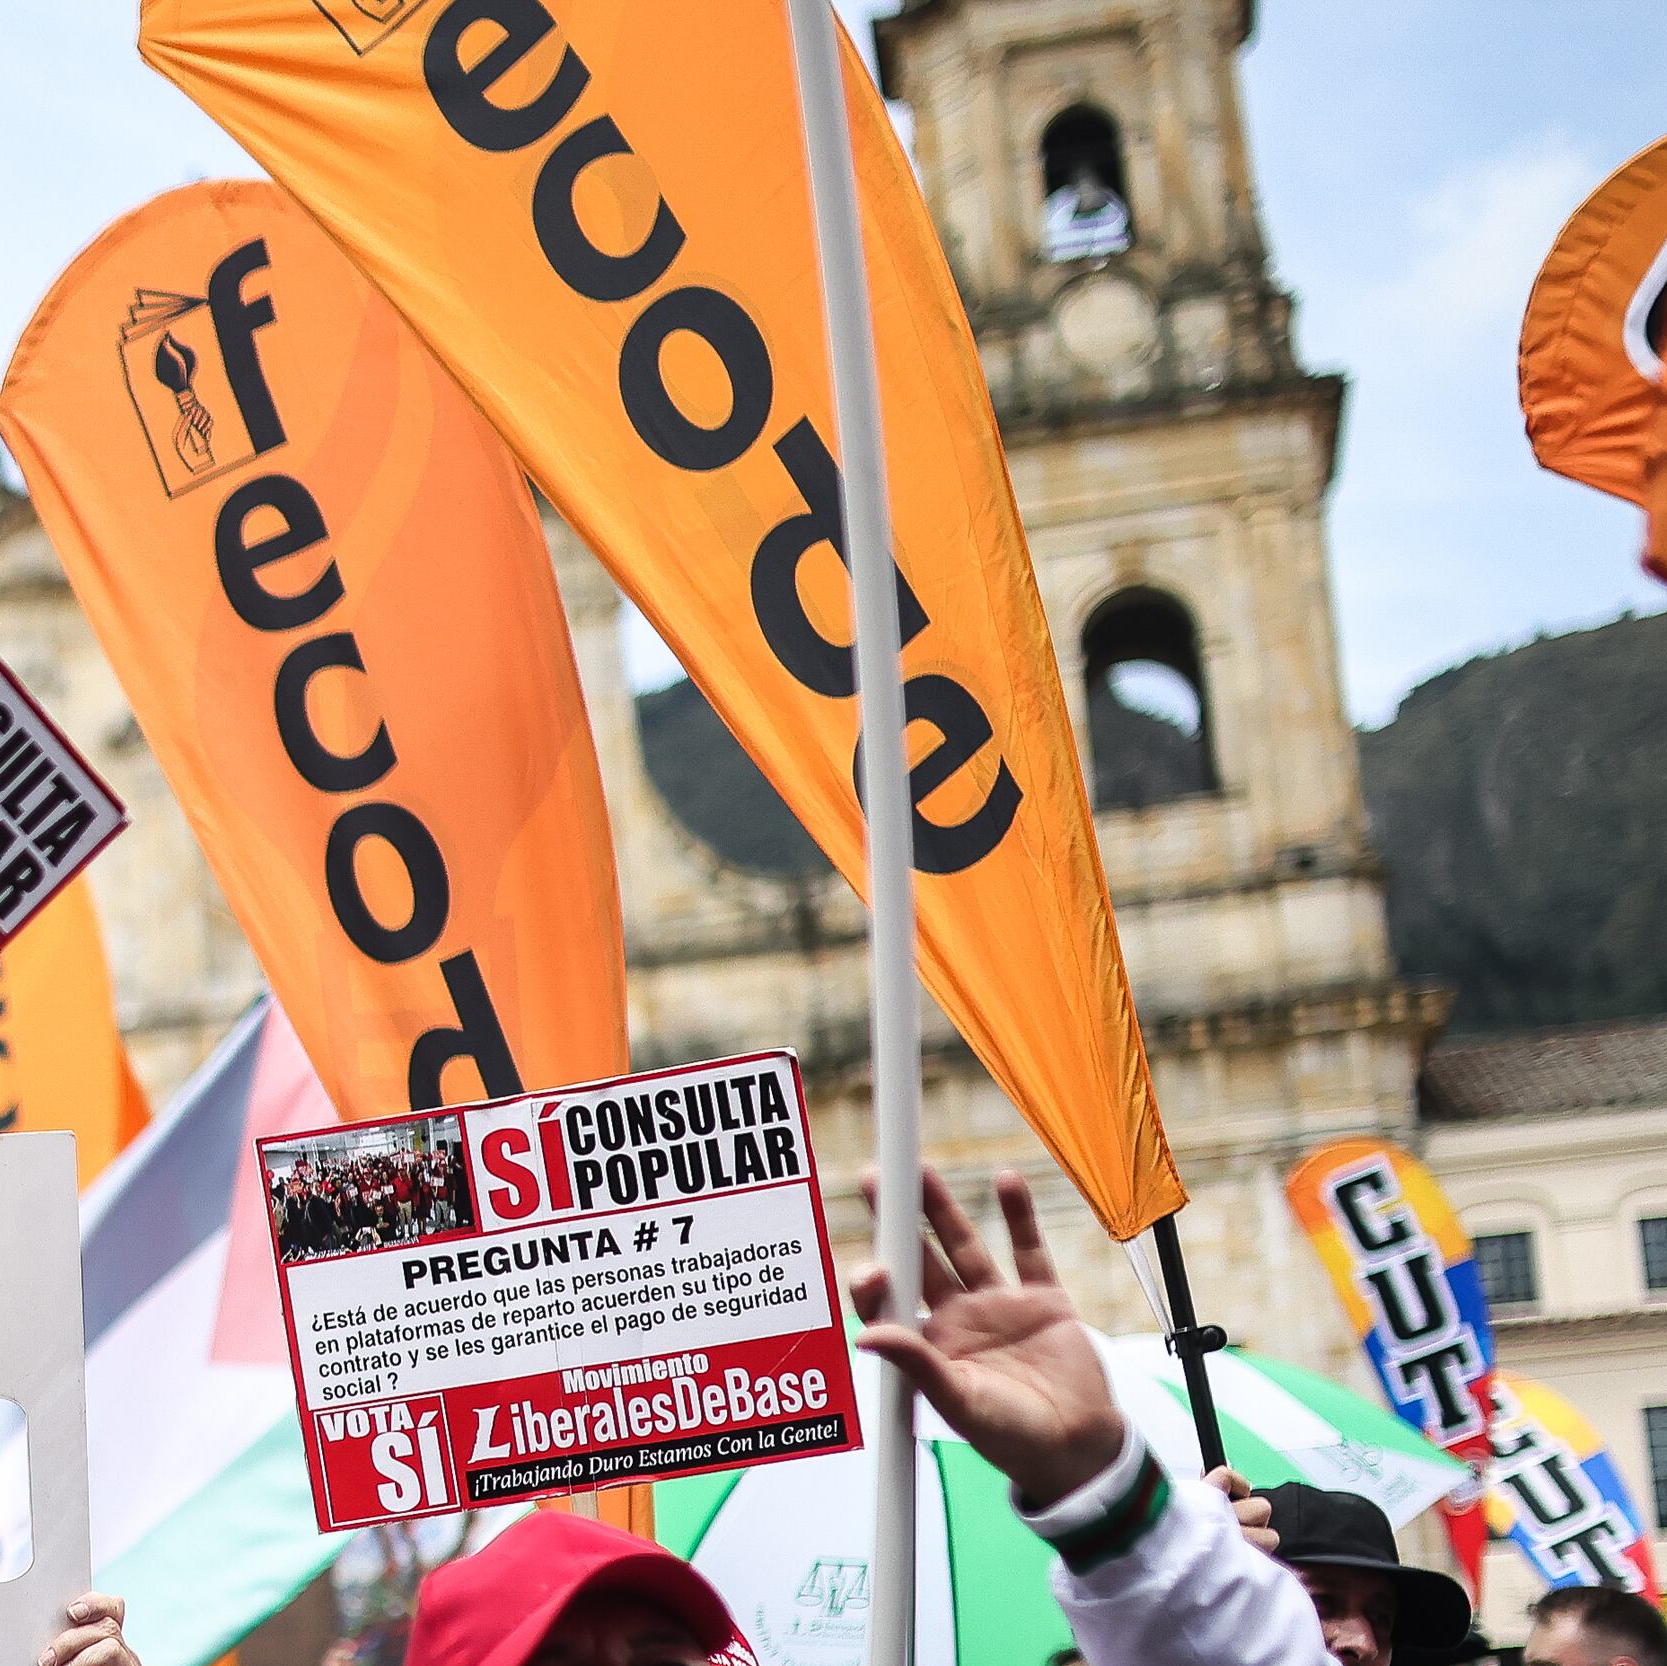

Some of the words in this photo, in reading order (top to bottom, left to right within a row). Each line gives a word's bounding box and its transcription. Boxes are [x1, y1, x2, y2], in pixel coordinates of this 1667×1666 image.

[480, 1101, 574, 1219] SÍ
[565, 1070, 790, 1155] CONSULTA
[573, 1126, 800, 1210] POPULAR
[311, 1305, 366, 1331] ¿Está
[373, 1303, 397, 1322] de
[404, 1289, 486, 1317] acuerdo
[493, 1284, 529, 1306] que
[535, 1278, 565, 1295] las
[571, 1262, 665, 1294] personas
[671, 1239, 801, 1274] trabajadoras
[401, 1227, 621, 1289] PREGUNTA
[633, 1220, 659, 1252] #
[671, 1214, 693, 1245] 7
[315, 1338, 339, 1355] en
[345, 1318, 465, 1354] plataformas
[471, 1311, 496, 1330] de
[502, 1299, 574, 1326] reparto
[581, 1284, 675, 1312] acuerden
[681, 1279, 706, 1296] su
[711, 1272, 751, 1293] tipo
[758, 1264, 784, 1283] de
[318, 1350, 401, 1377] contrato
[425, 1344, 448, 1360] se
[454, 1338, 484, 1356] les
[491, 1322, 584, 1355] garantice
[590, 1314, 607, 1333] el
[614, 1310, 665, 1335] pago
[671, 1302, 696, 1321] de
[703, 1282, 807, 1316] seguridad
[1331, 1160, 1481, 1440] CUT
[322, 1374, 380, 1400] social
[467, 1367, 827, 1464] LiberalesDeBase
[561, 1353, 708, 1393] Movimiento
[320, 1402, 414, 1441] VOTA
[371, 1410, 447, 1512] SÍ
[475, 1459, 583, 1496] ¡Trabajando
[588, 1455, 633, 1474] Duro
[638, 1443, 711, 1467] Estamos
[717, 1436, 752, 1455] Con
[758, 1430, 775, 1448] la
[781, 1419, 837, 1445] Gente!
